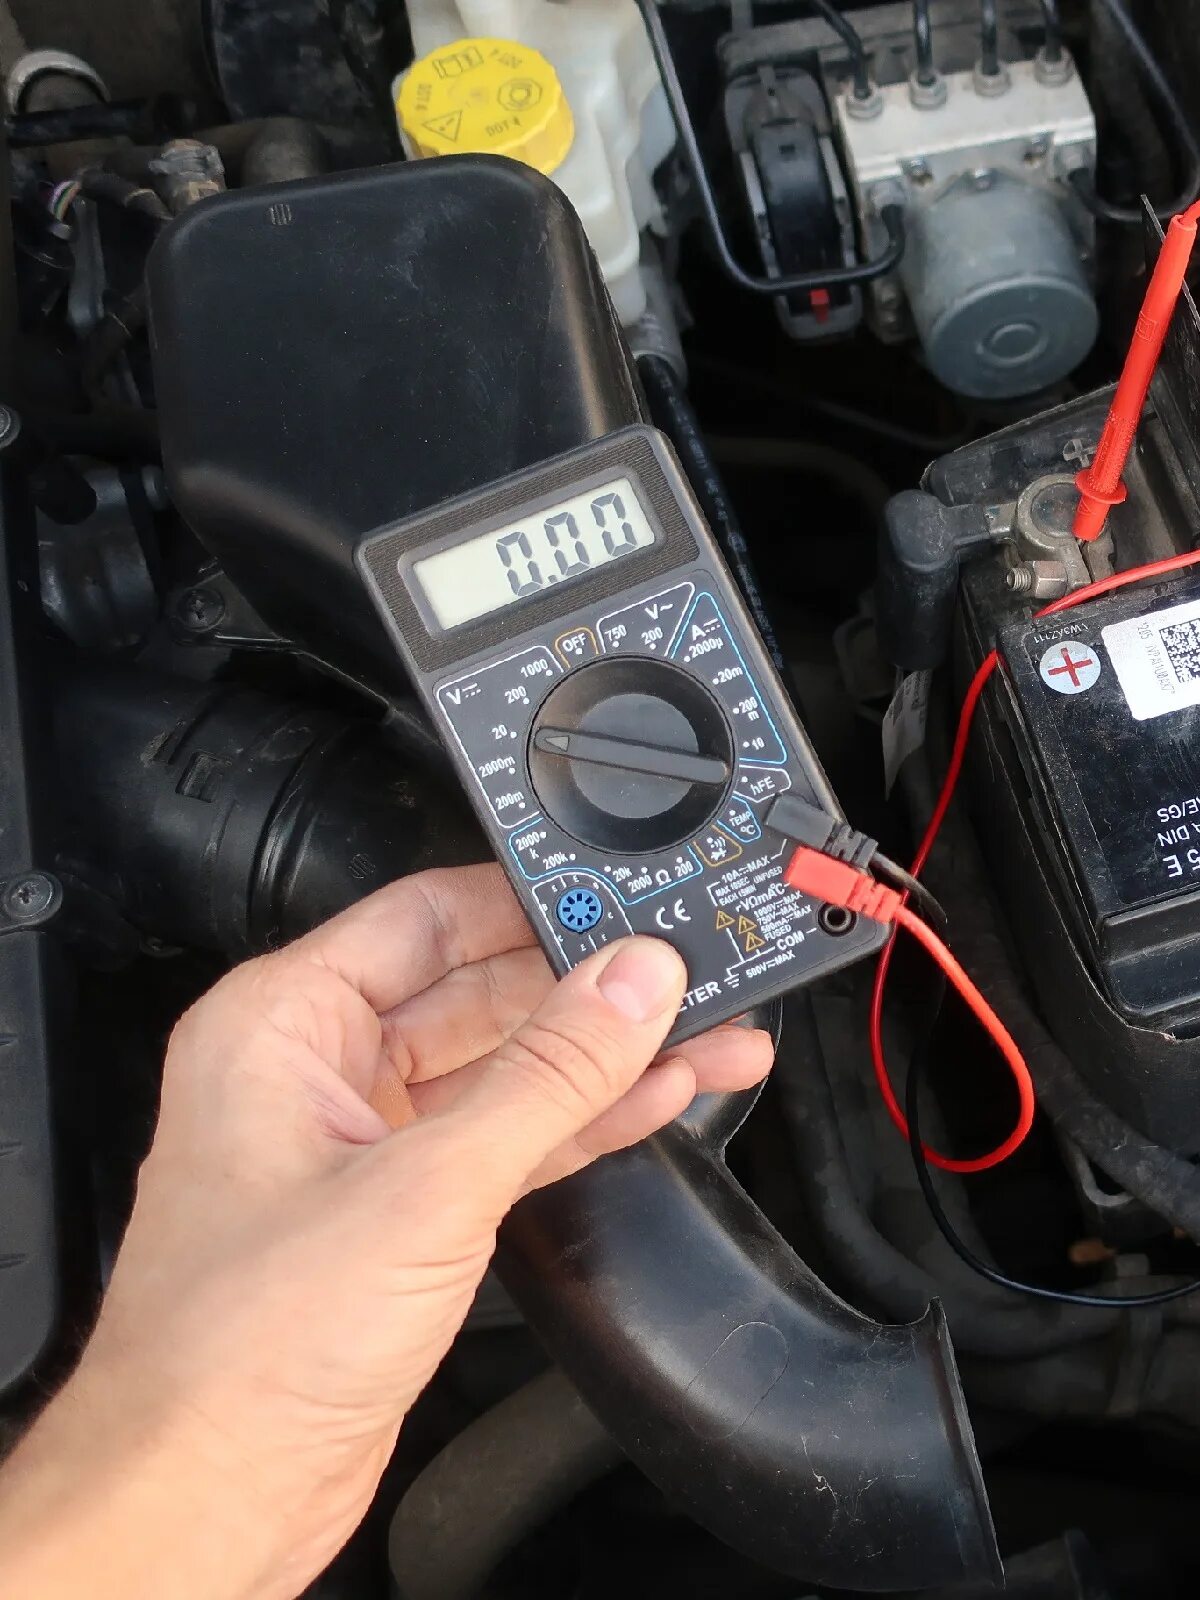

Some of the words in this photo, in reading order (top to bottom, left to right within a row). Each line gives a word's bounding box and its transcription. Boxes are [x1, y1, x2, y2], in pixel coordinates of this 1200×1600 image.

[485, 119, 509, 136] DOT
[514, 116, 522, 126] 4
[496, 493, 638, 596] 0.00
[562, 633, 587, 652] OFF
[604, 624, 627, 642] 750
[641, 628, 664, 645] 200
[520, 659, 548, 678] 1000
[718, 666, 744, 684] 20m
[504, 686, 526, 704] 200
[739, 697, 758, 714] 200
[492, 724, 508, 740] 20
[752, 738, 764, 750] 10
[478, 756, 516, 778] 2000m
[752, 777, 776, 796] hFE
[496, 791, 524, 810] 200m
[729, 810, 752, 827] TEMP
[516, 832, 540, 851] 2000
[1157, 825, 1190, 846] DIN
[530, 848, 540, 860] k
[543, 854, 568, 870] 200k
[612, 866, 633, 882] 20k
[1162, 854, 1183, 878] E
[628, 875, 652, 894] 2000
[674, 860, 694, 877] 200
[715, 886, 731, 897] MAX
[754, 866, 783, 884] UNFUSED
[720, 893, 738, 906] EACH
[656, 898, 692, 930] CE
[764, 924, 792, 941] FUSED
[776, 930, 805, 951] COM
[678, 982, 720, 1012] TER
